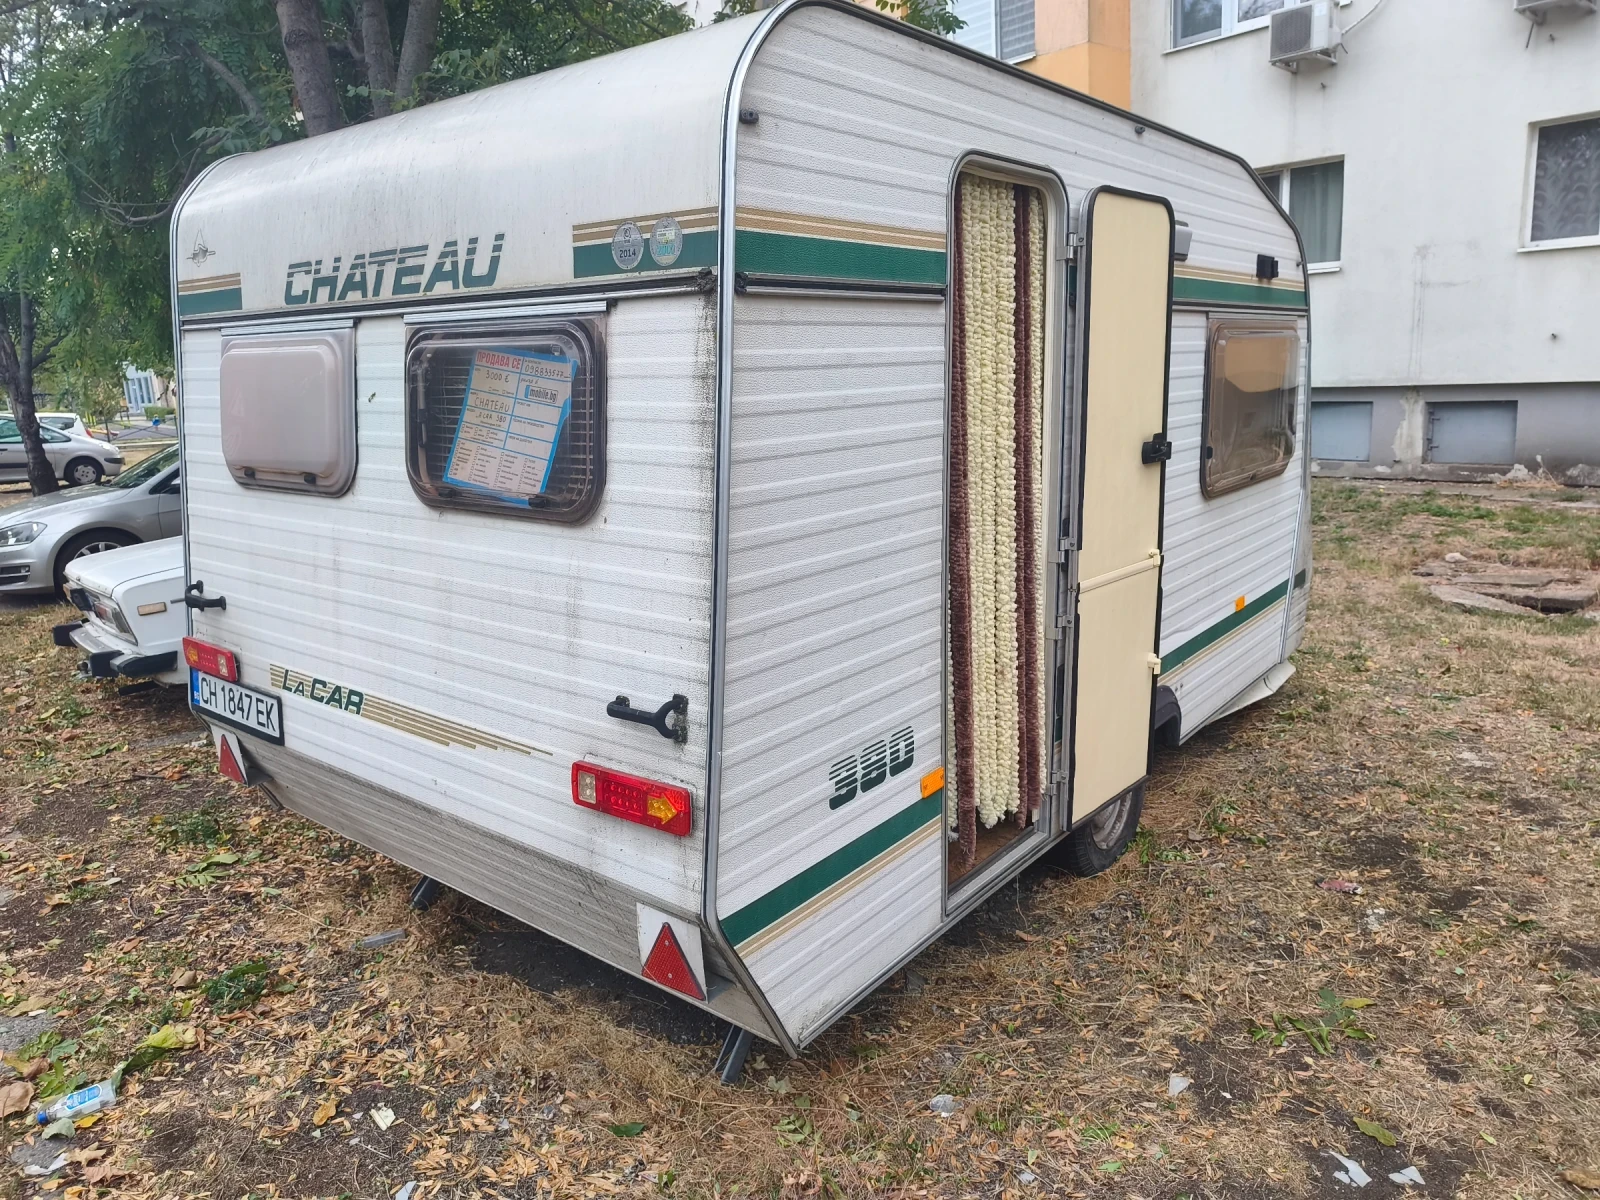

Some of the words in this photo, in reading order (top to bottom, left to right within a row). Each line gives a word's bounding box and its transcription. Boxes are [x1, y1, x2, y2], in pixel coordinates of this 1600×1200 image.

[619, 248, 637, 259] 2014
[284, 232, 505, 306] CHATEAU
[476, 351, 510, 368] ПРОДАВА
[511, 357, 522, 370] СЕ
[485, 369, 503, 381] 3000
[474, 396, 510, 413] CHATEAU
[529, 388, 557, 403] mobile.bg
[221, 684, 253, 721] 1847
[255, 697, 277, 732] EK
[828, 725, 915, 811] 380
